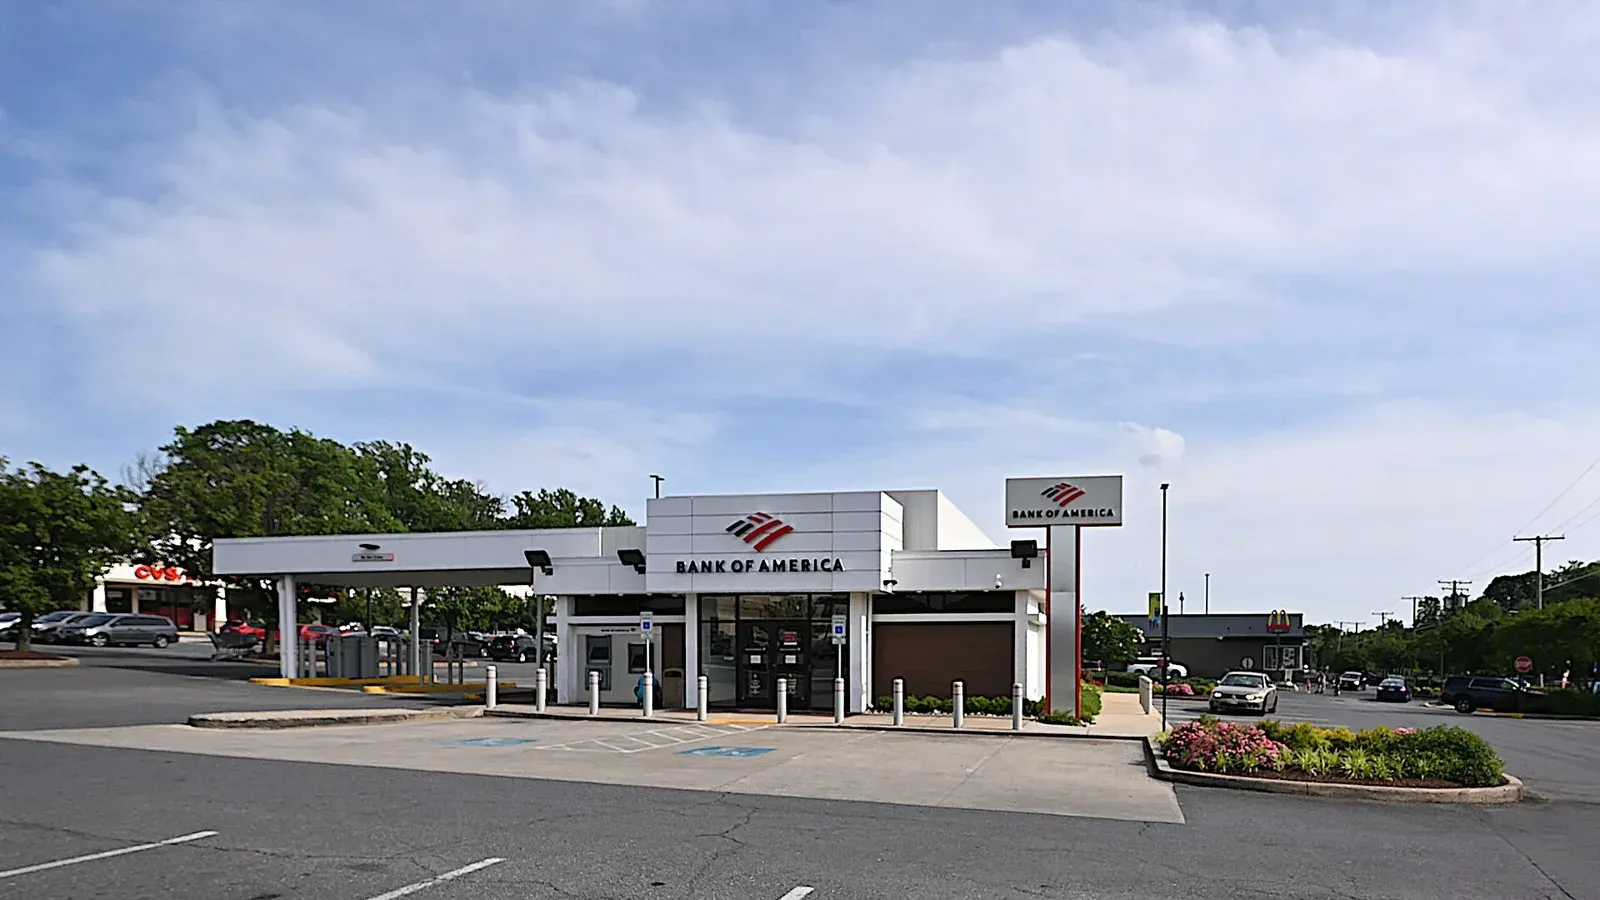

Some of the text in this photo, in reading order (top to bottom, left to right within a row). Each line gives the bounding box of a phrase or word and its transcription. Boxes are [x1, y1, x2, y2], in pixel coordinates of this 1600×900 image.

[1012, 508, 1115, 519] BANK OF AMERICA
[676, 558, 846, 574] BANK OF AMERICA
[134, 566, 179, 581] CVS
[1515, 660, 1532, 668] STOP
